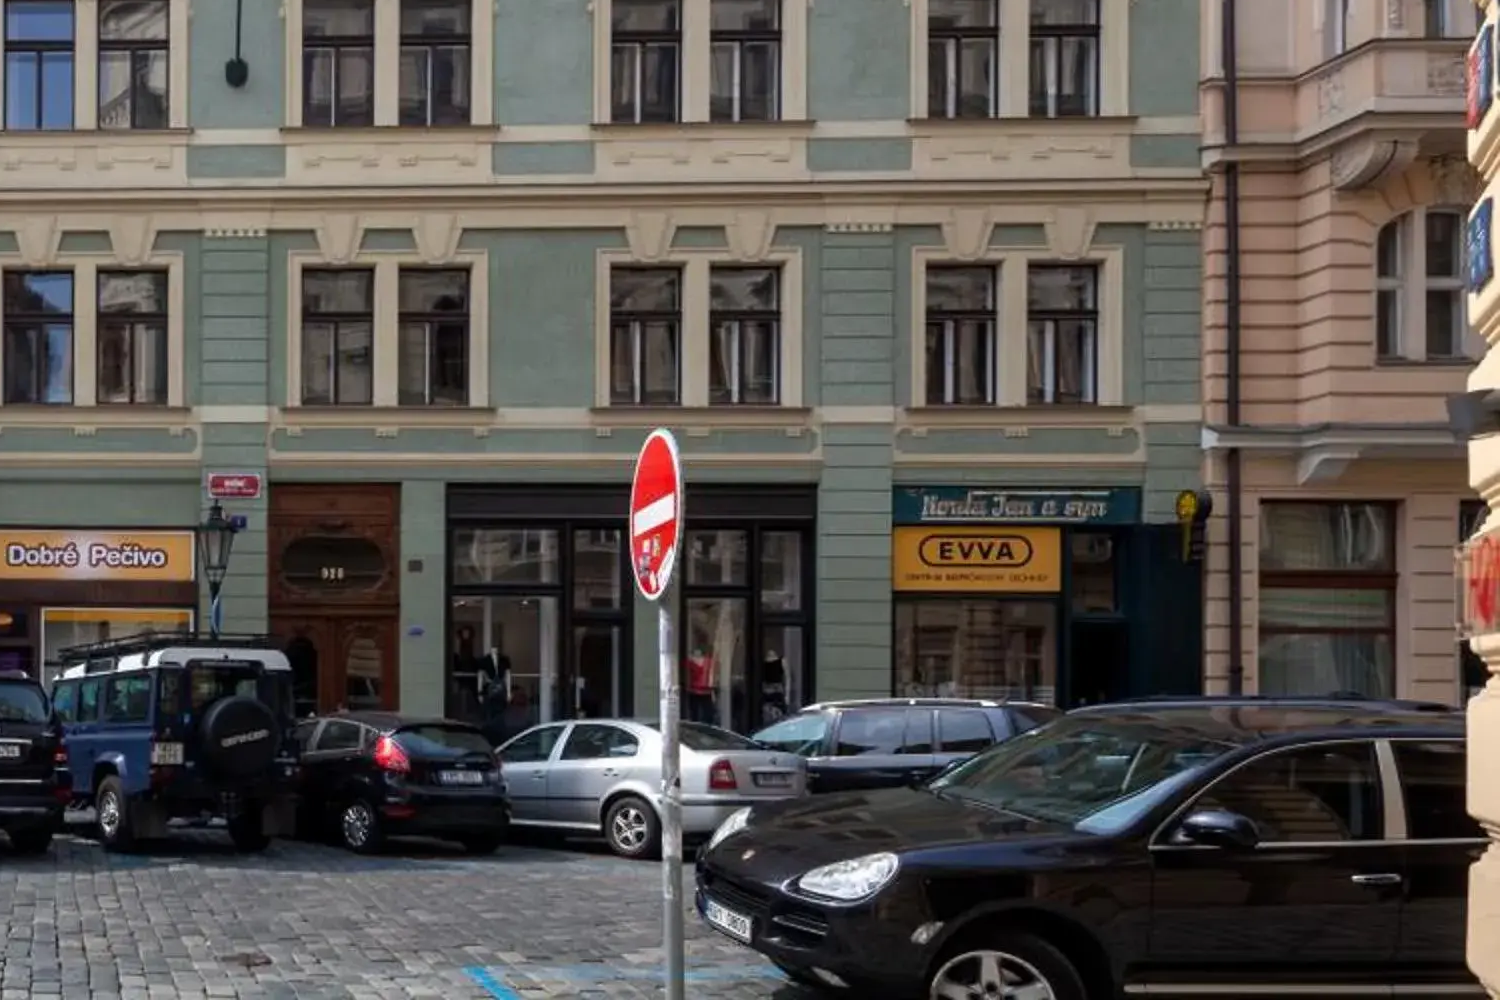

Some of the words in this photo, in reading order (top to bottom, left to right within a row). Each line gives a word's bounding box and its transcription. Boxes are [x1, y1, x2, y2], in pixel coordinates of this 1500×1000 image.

[7, 543, 78, 567] Dobré
[89, 543, 168, 567] Pečivo
[938, 541, 1015, 561] EVVA
